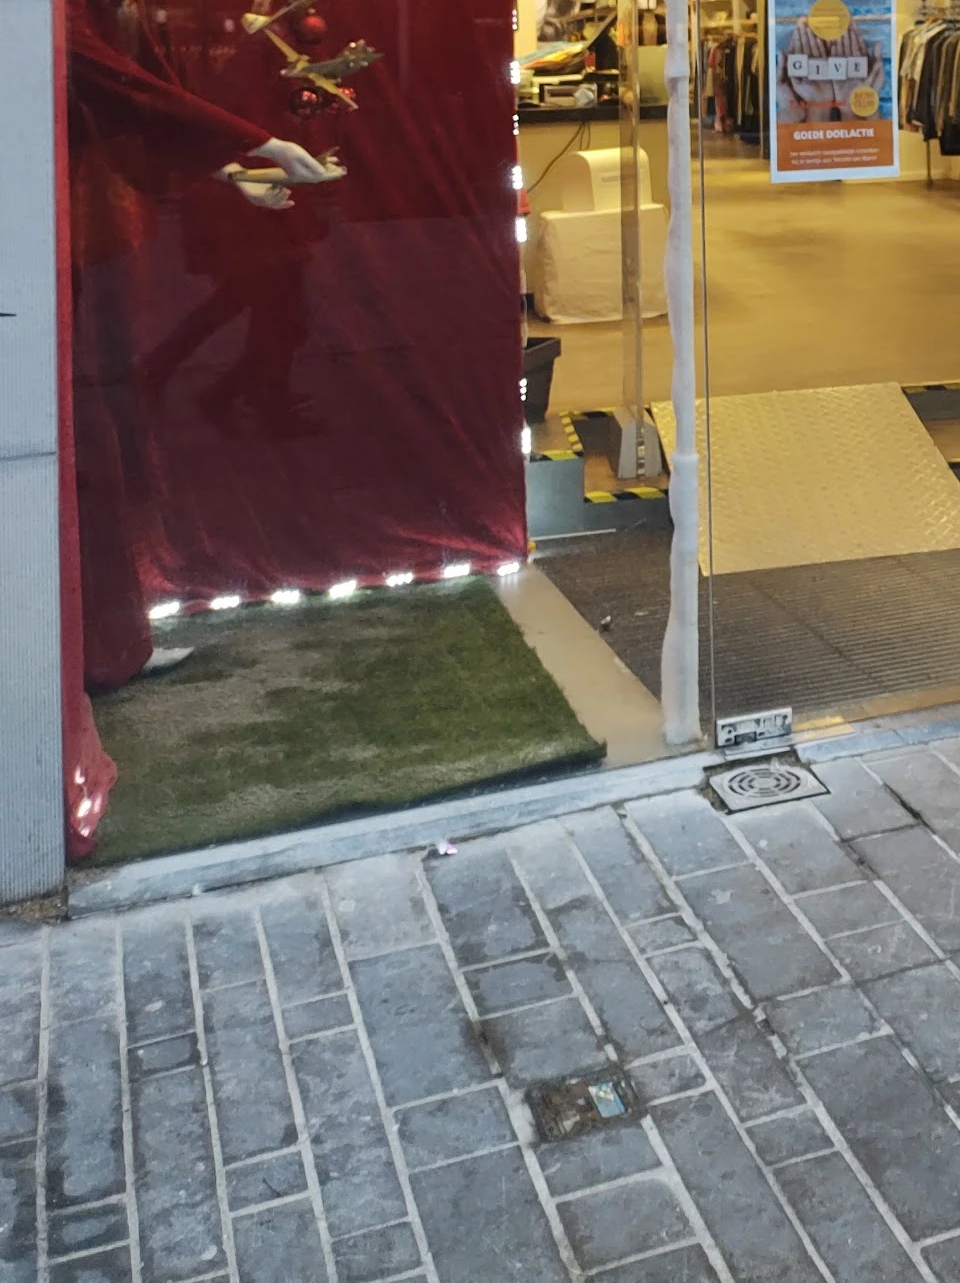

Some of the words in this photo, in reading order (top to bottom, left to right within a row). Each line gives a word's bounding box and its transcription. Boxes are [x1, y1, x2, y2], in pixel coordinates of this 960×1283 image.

[793, 61, 861, 75] GIVE
[793, 130, 824, 140] GOEDE
[826, 128, 874, 139] DOELACTIE
